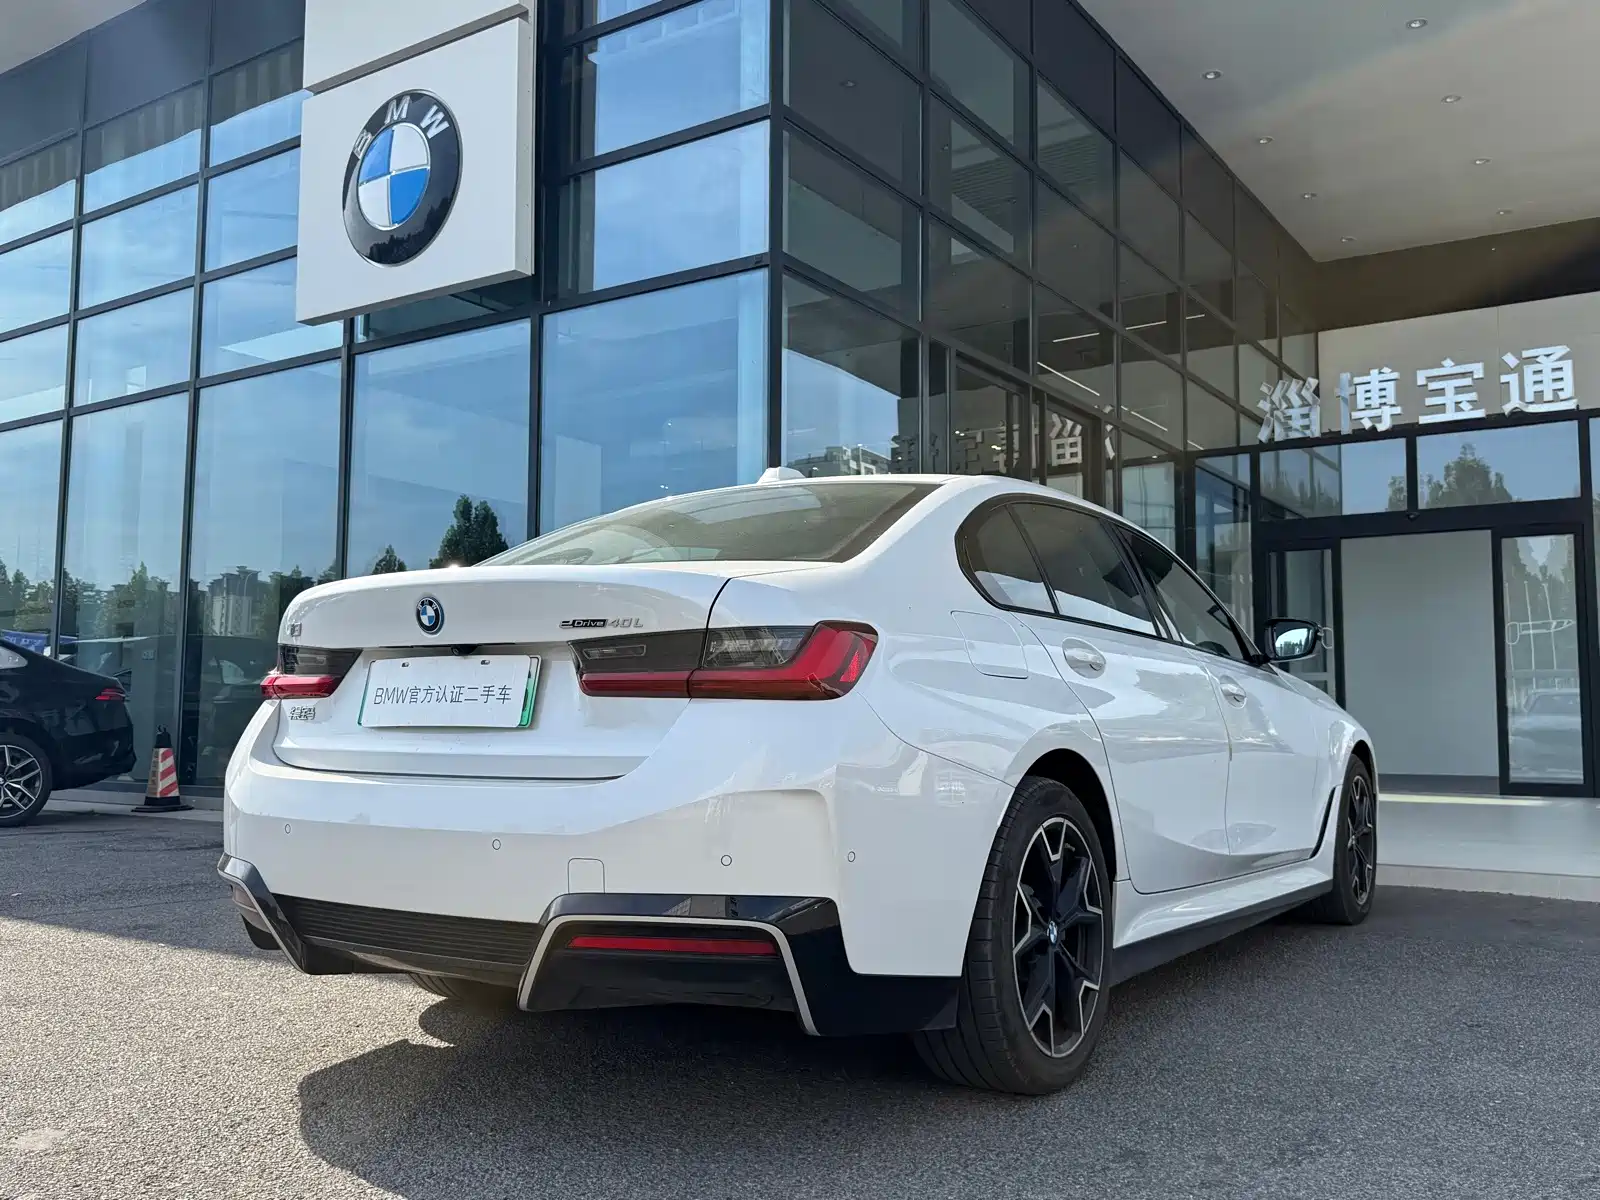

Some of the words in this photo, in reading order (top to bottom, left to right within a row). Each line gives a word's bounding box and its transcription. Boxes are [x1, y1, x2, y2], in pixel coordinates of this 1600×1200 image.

[353, 95, 450, 159] BMW
[1257, 345, 1579, 443] 淄博宝通
[373, 684, 513, 705] BMW官方认证二手车
